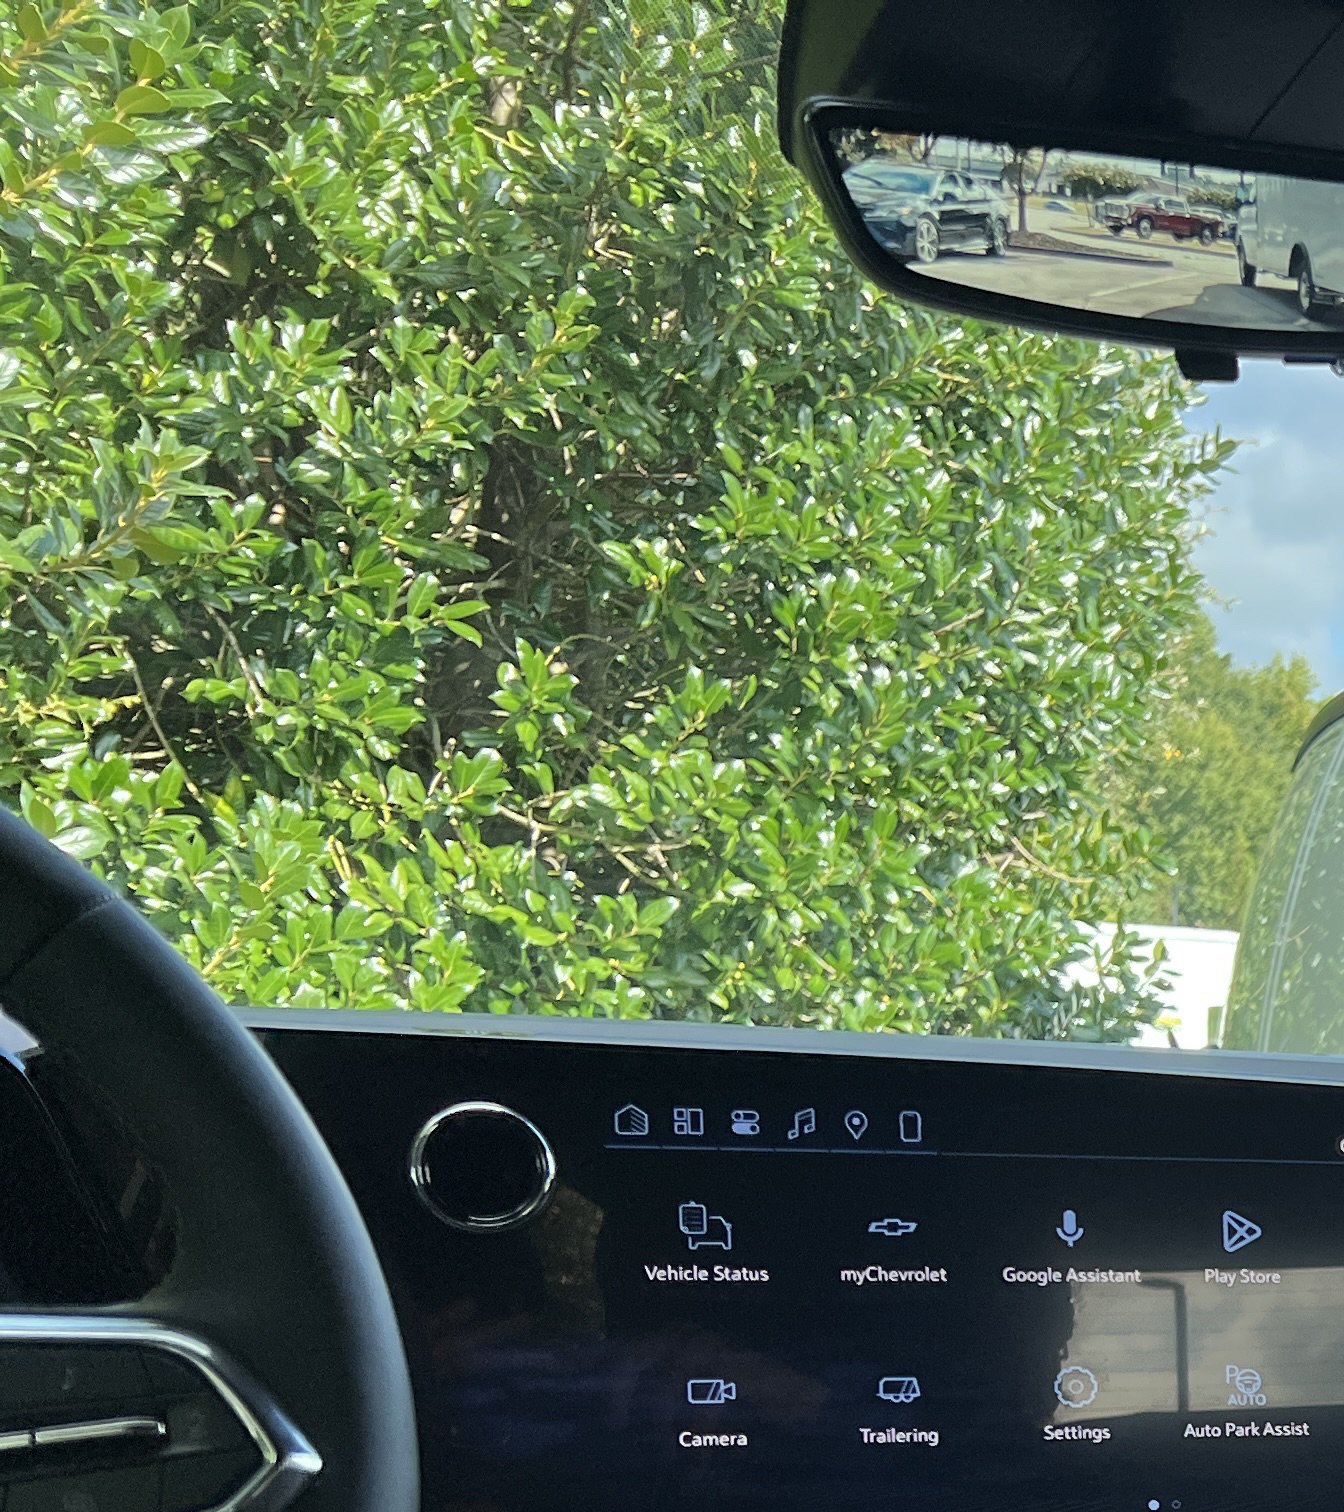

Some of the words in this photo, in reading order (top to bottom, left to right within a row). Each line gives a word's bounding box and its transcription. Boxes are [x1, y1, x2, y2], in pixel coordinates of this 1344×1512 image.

[644, 1264, 709, 1282] Vehicle
[713, 1264, 769, 1283] Status
[840, 1265, 947, 1286] myChevrolet
[1002, 1266, 1063, 1287] Google
[1065, 1267, 1143, 1284] Assistant
[1204, 1268, 1235, 1287] Play
[1240, 1268, 1281, 1285] Store
[678, 1431, 748, 1448] Camera
[859, 1427, 939, 1447] Trailering
[1043, 1425, 1111, 1444] Settings
[1183, 1423, 1222, 1438] Auto
[1225, 1422, 1260, 1438] Park
[1262, 1422, 1310, 1437] Assist
